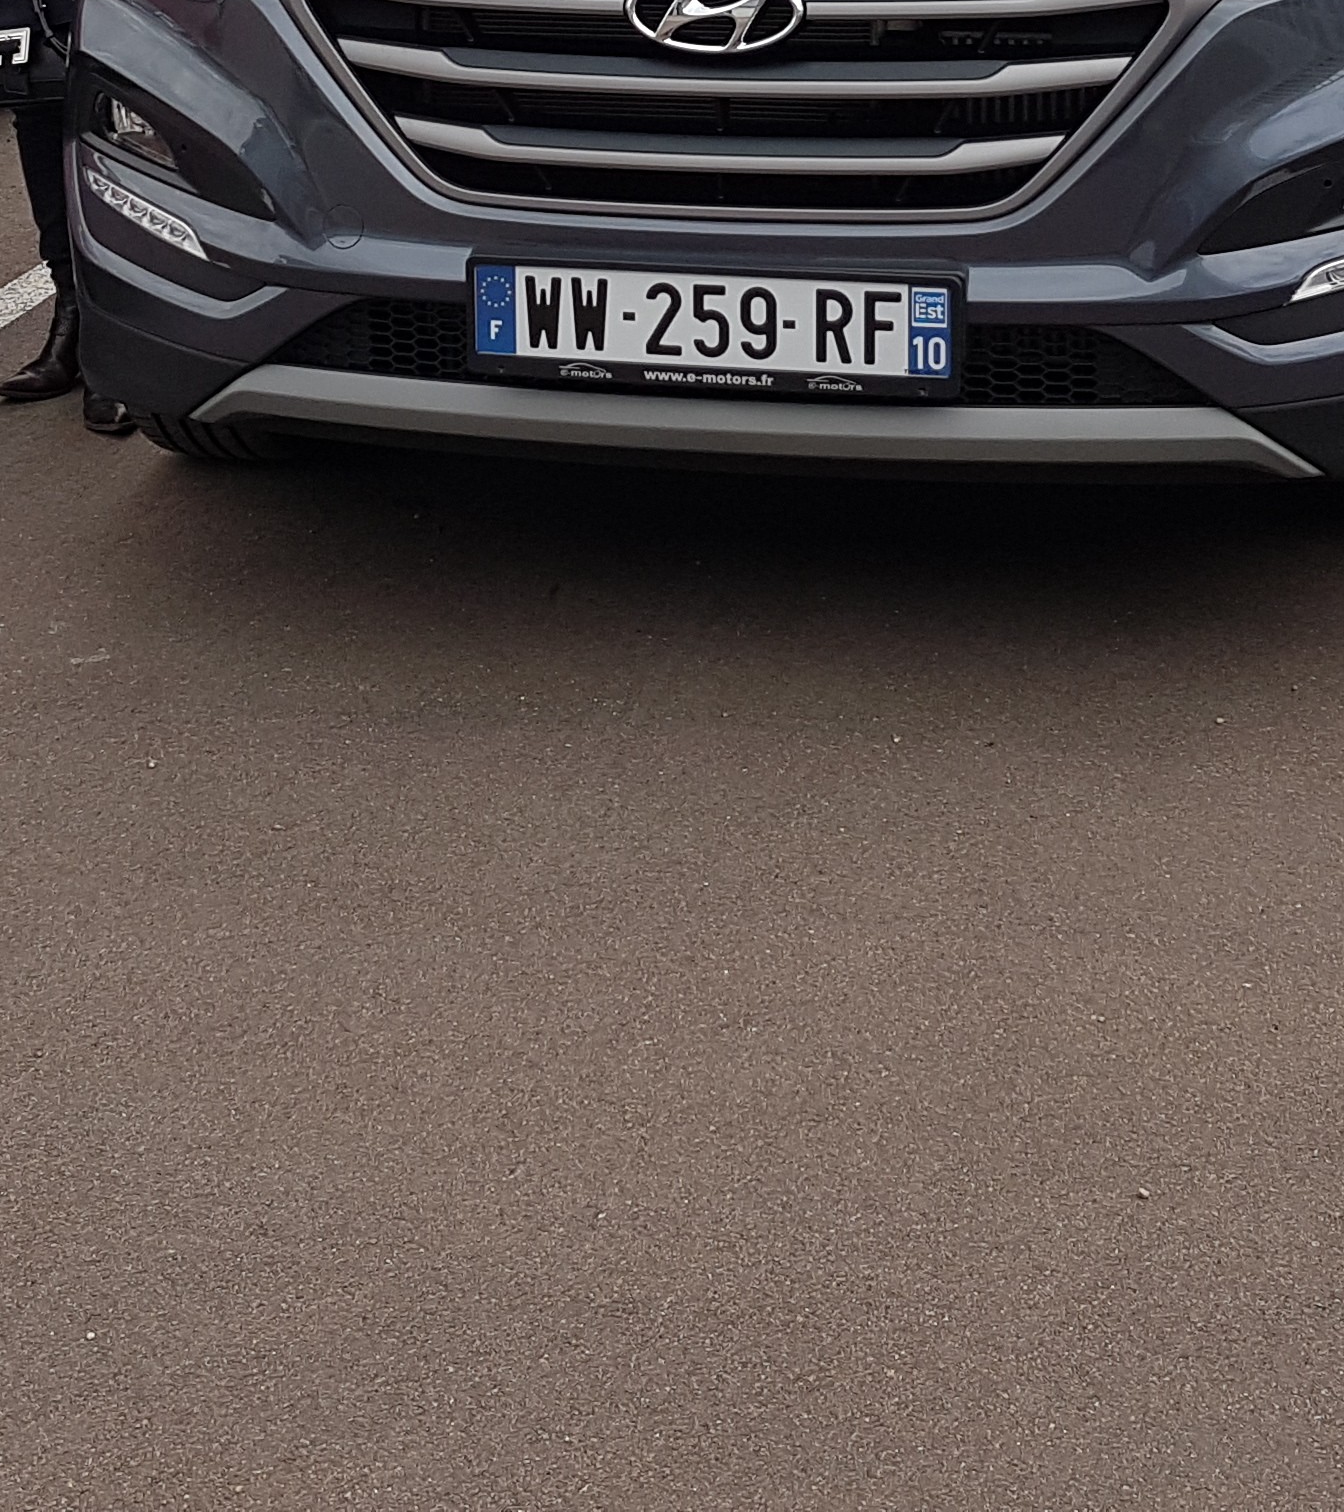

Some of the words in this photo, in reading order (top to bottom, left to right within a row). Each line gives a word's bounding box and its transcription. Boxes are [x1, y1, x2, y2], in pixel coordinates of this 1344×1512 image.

[915, 294, 945, 304] Grand
[915, 303, 945, 319] Est
[489, 320, 503, 341] F
[912, 335, 947, 370] 10
[643, 369, 775, 387] www.e-motors.fr
